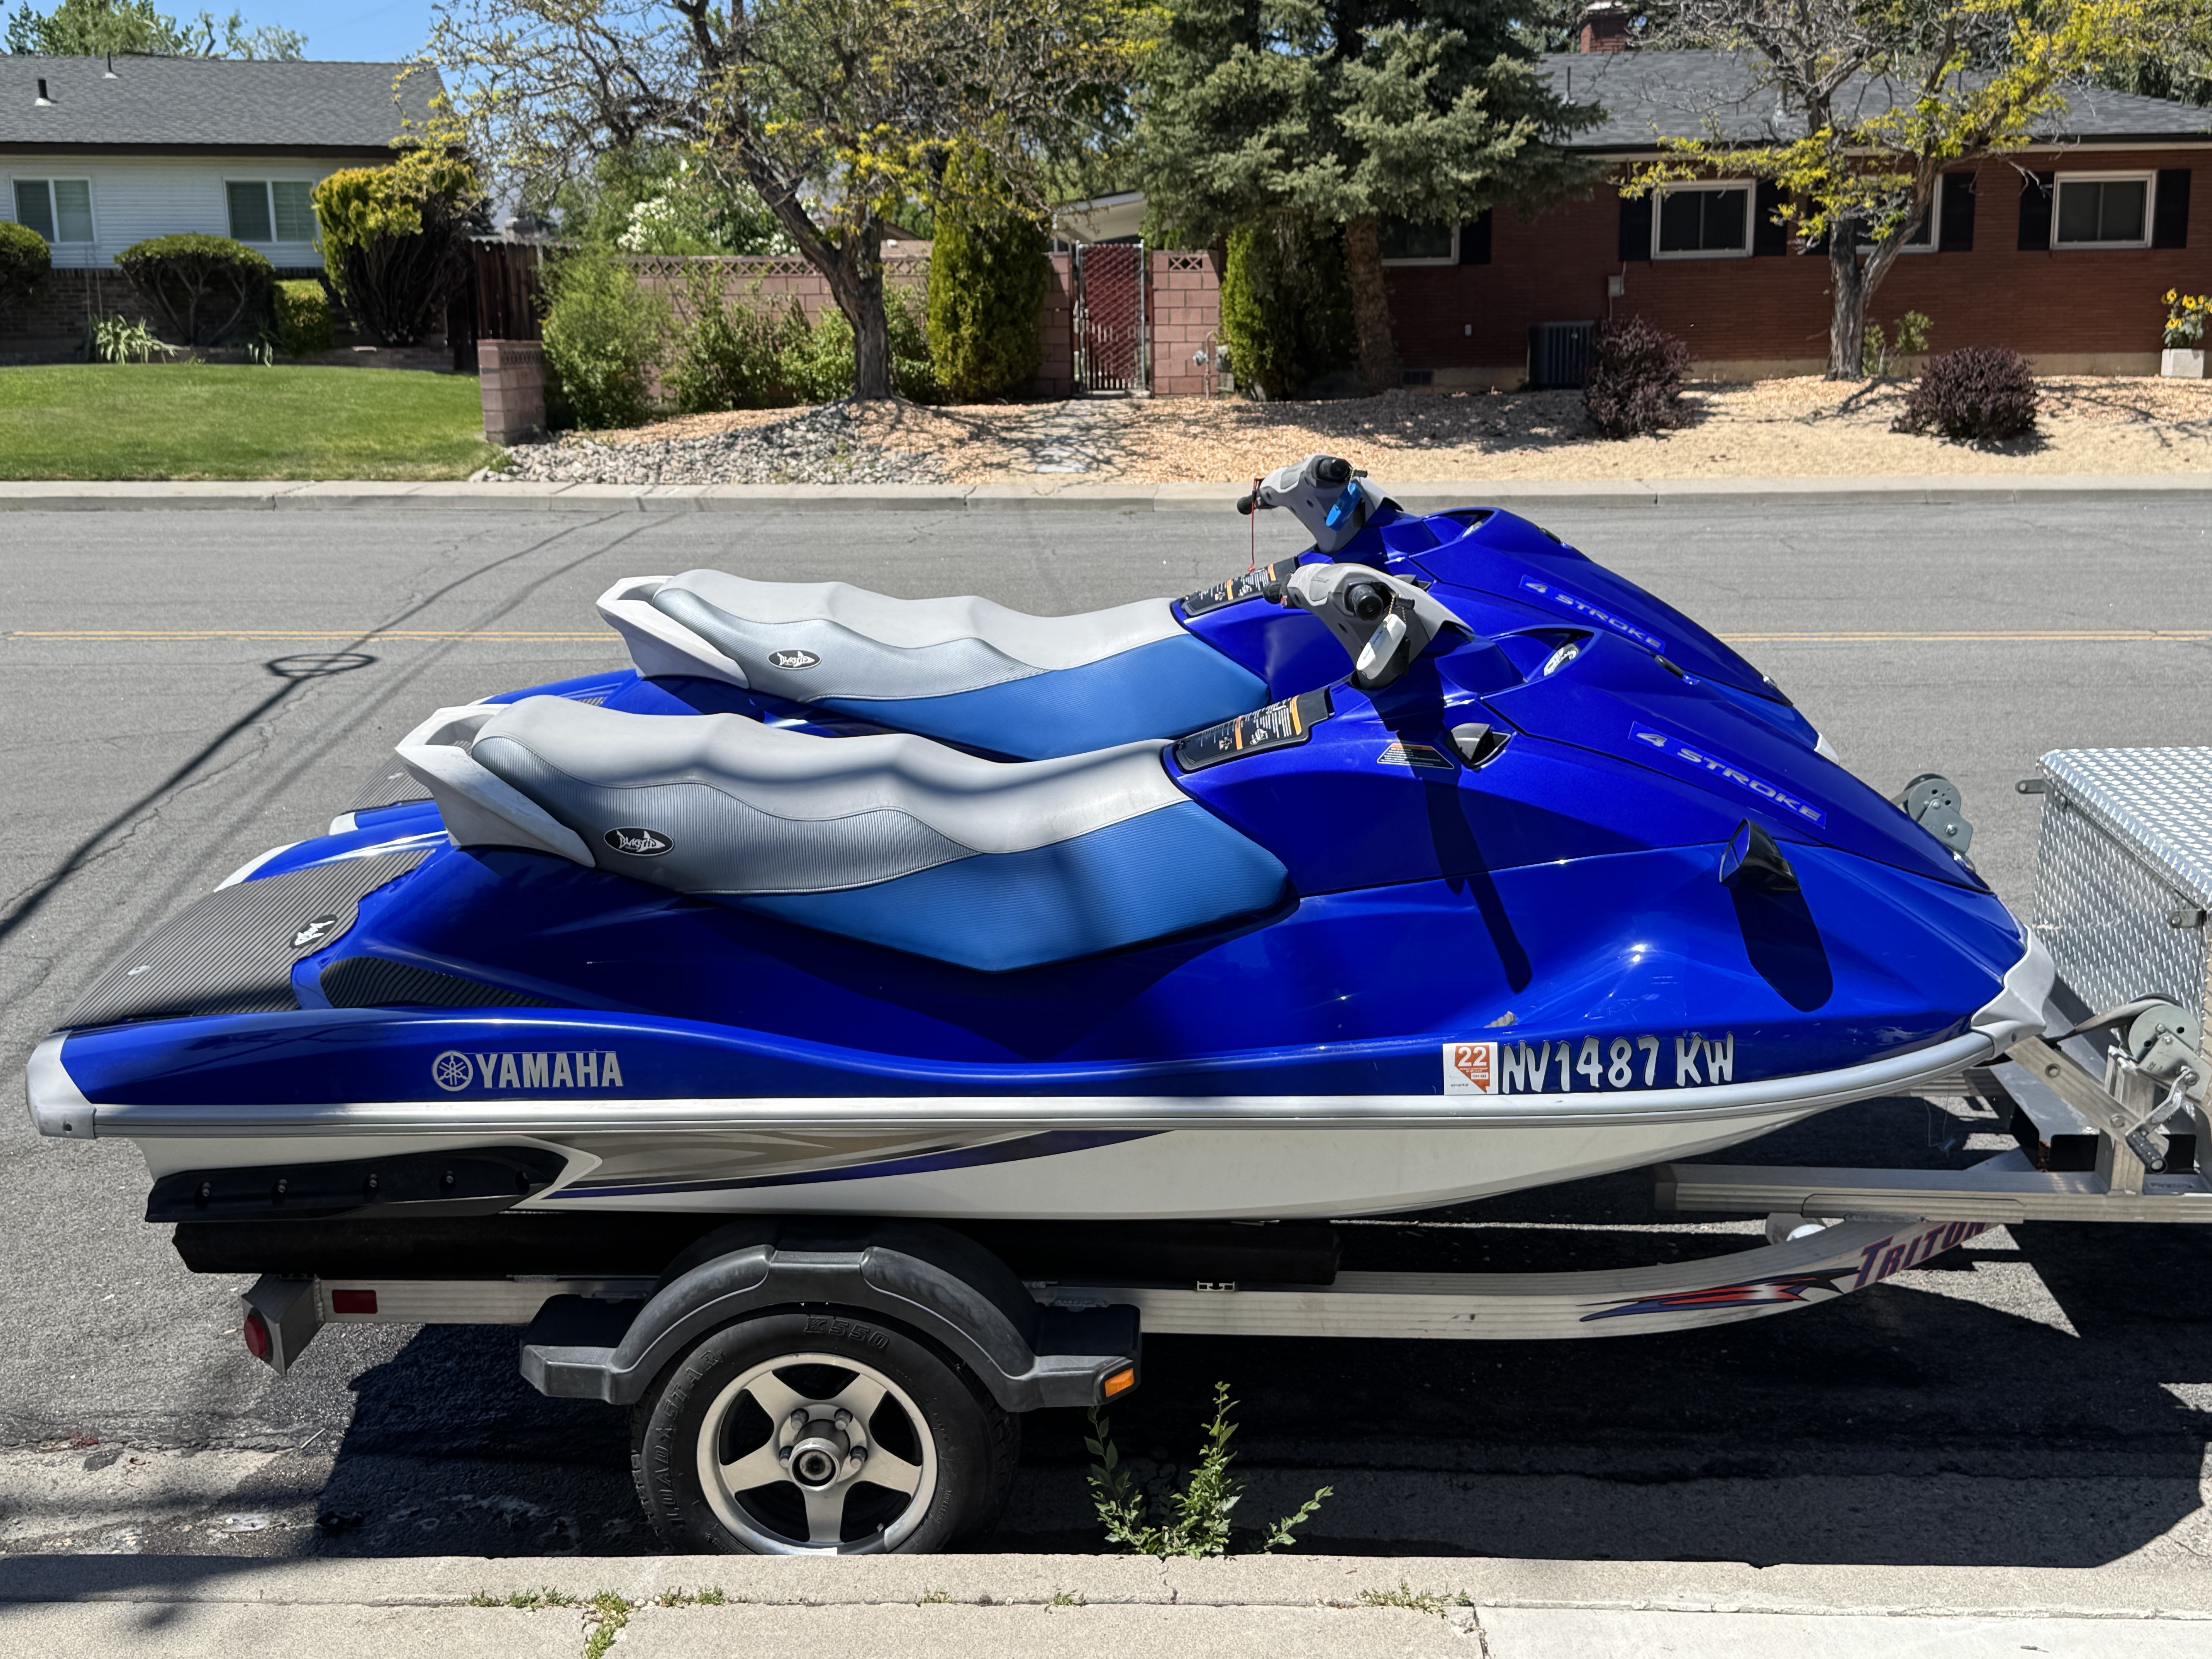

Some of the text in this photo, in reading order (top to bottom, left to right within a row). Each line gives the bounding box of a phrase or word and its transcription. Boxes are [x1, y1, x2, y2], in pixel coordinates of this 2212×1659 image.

[1525, 582, 1661, 648] 4 STROKE
[1636, 732, 1821, 821] 4 STROKE
[475, 1052, 623, 1089] YAMAHA
[1458, 1046, 1487, 1066] 22
[1675, 1032, 1734, 1086] KW
